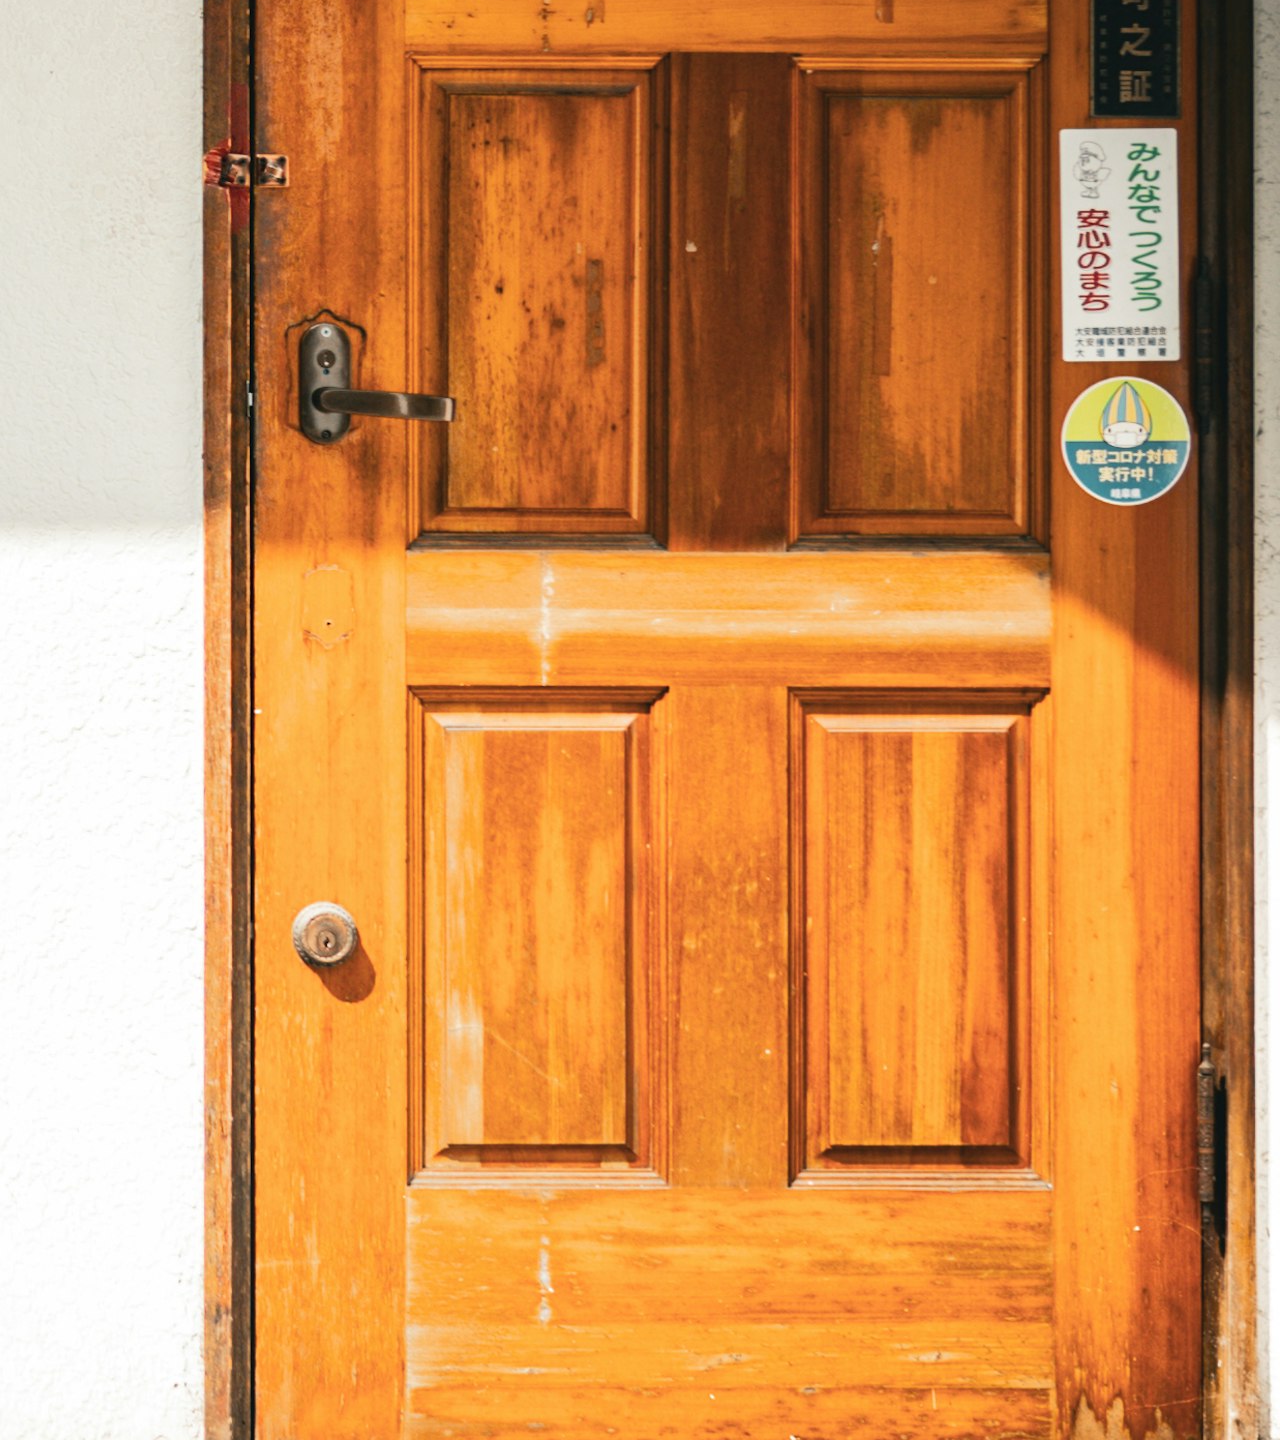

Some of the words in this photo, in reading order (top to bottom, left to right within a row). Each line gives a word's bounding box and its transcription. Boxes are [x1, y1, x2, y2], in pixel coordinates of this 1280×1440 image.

[1077, 208, 1111, 312] 安心のまち
[1075, 448, 1178, 465] 新型コロナ対策
